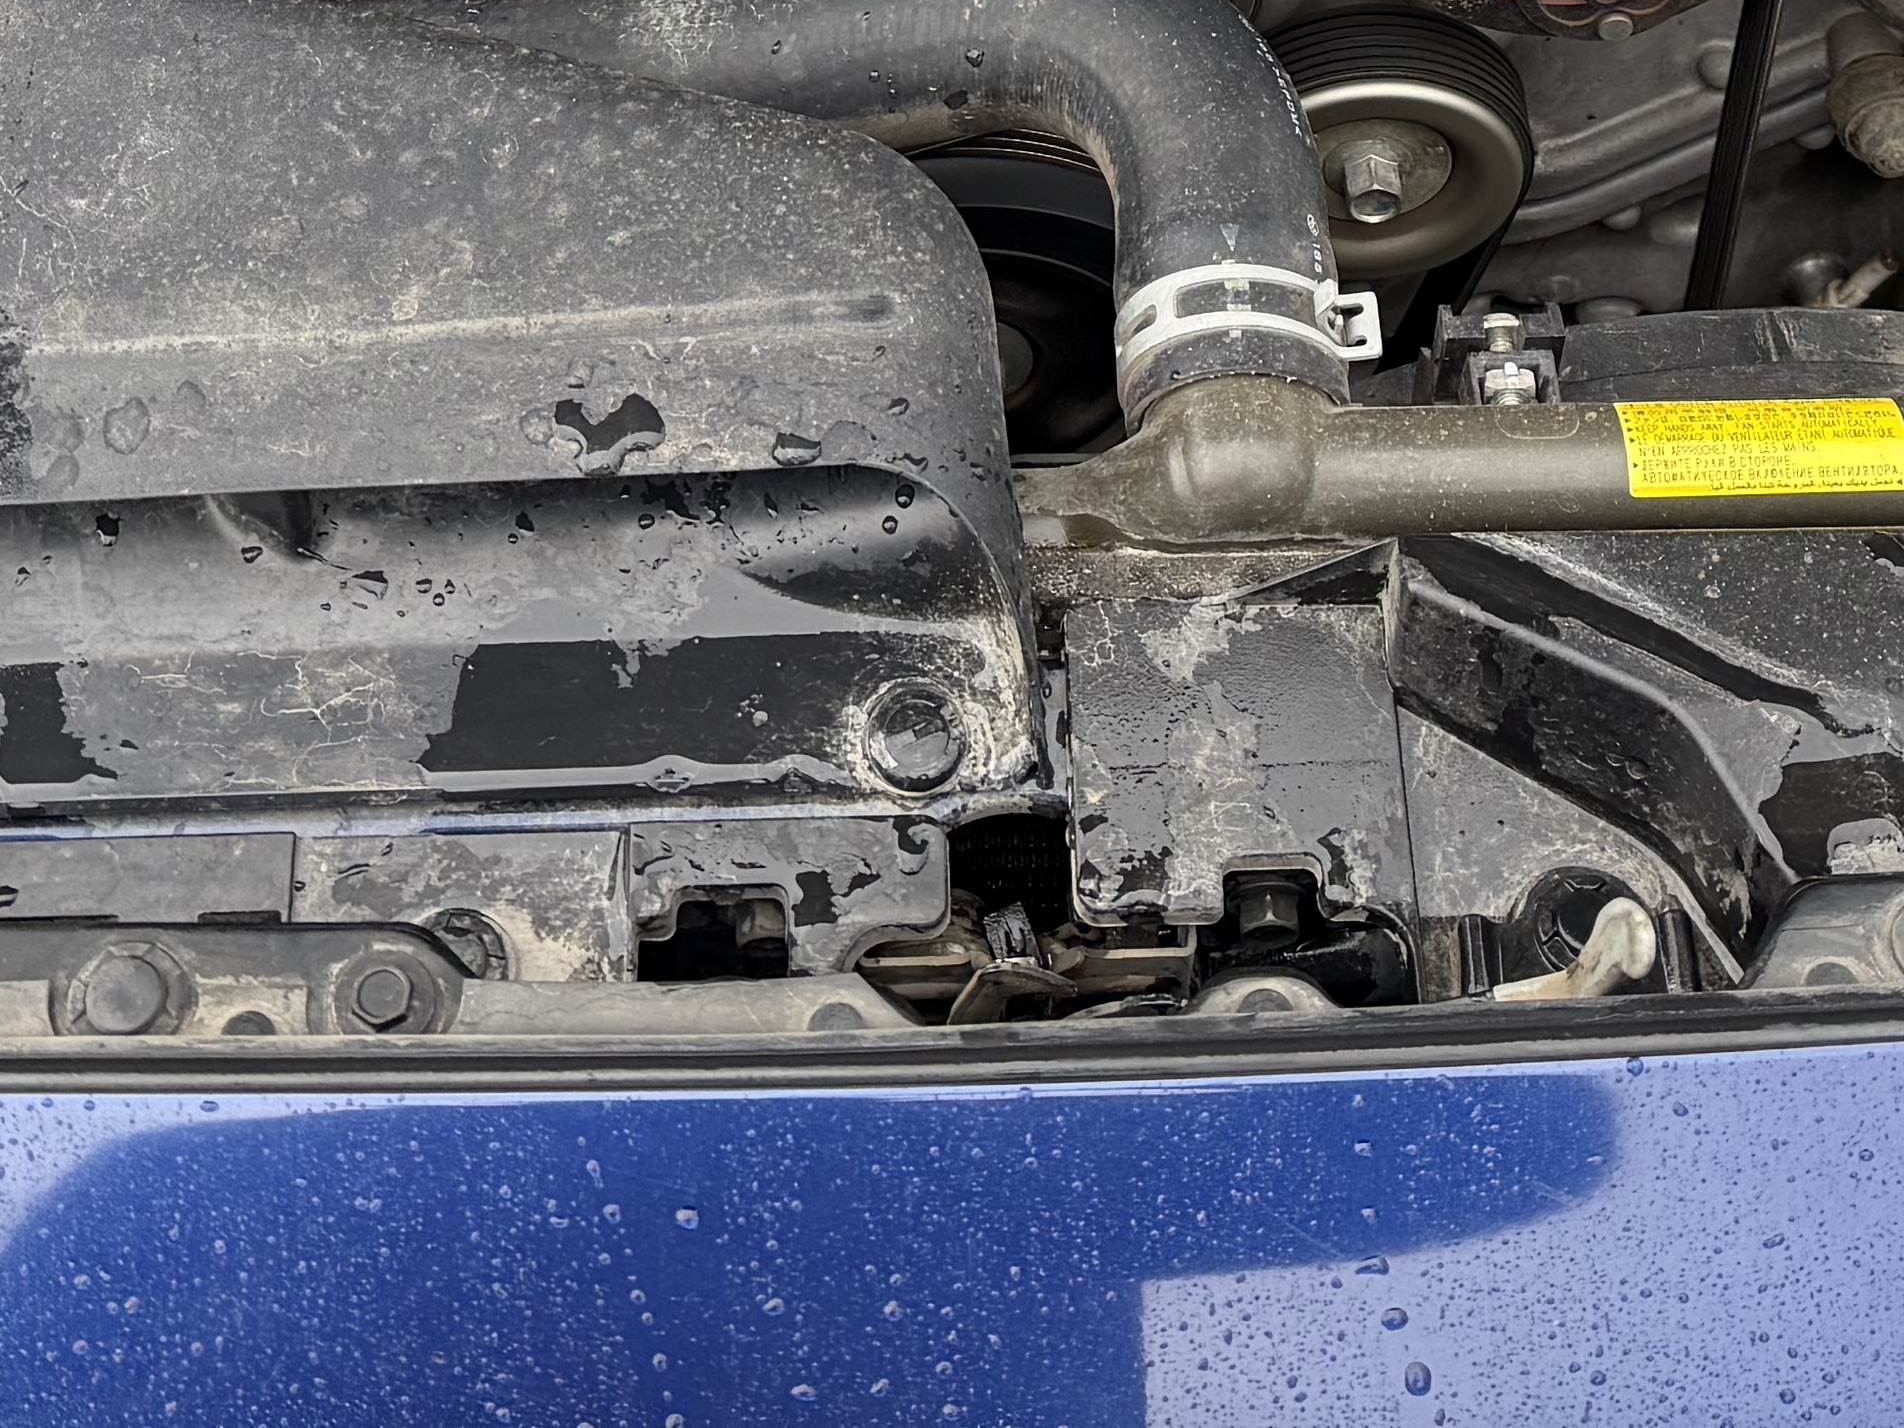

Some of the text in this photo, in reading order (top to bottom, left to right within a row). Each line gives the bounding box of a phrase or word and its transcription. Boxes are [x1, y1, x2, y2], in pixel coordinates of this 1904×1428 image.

[1832, 427, 1897, 439] AUTOMATIQUE
[1732, 443, 1753, 454] PAS
[1759, 442, 1778, 454] LES
[1642, 457, 1694, 471] ДЕРЖИТЕ
[1642, 468, 1746, 484] АВТОМАТИЧЕСКОЕ
[1748, 466, 1816, 481] ВКЛЮЧЕНИЕ
